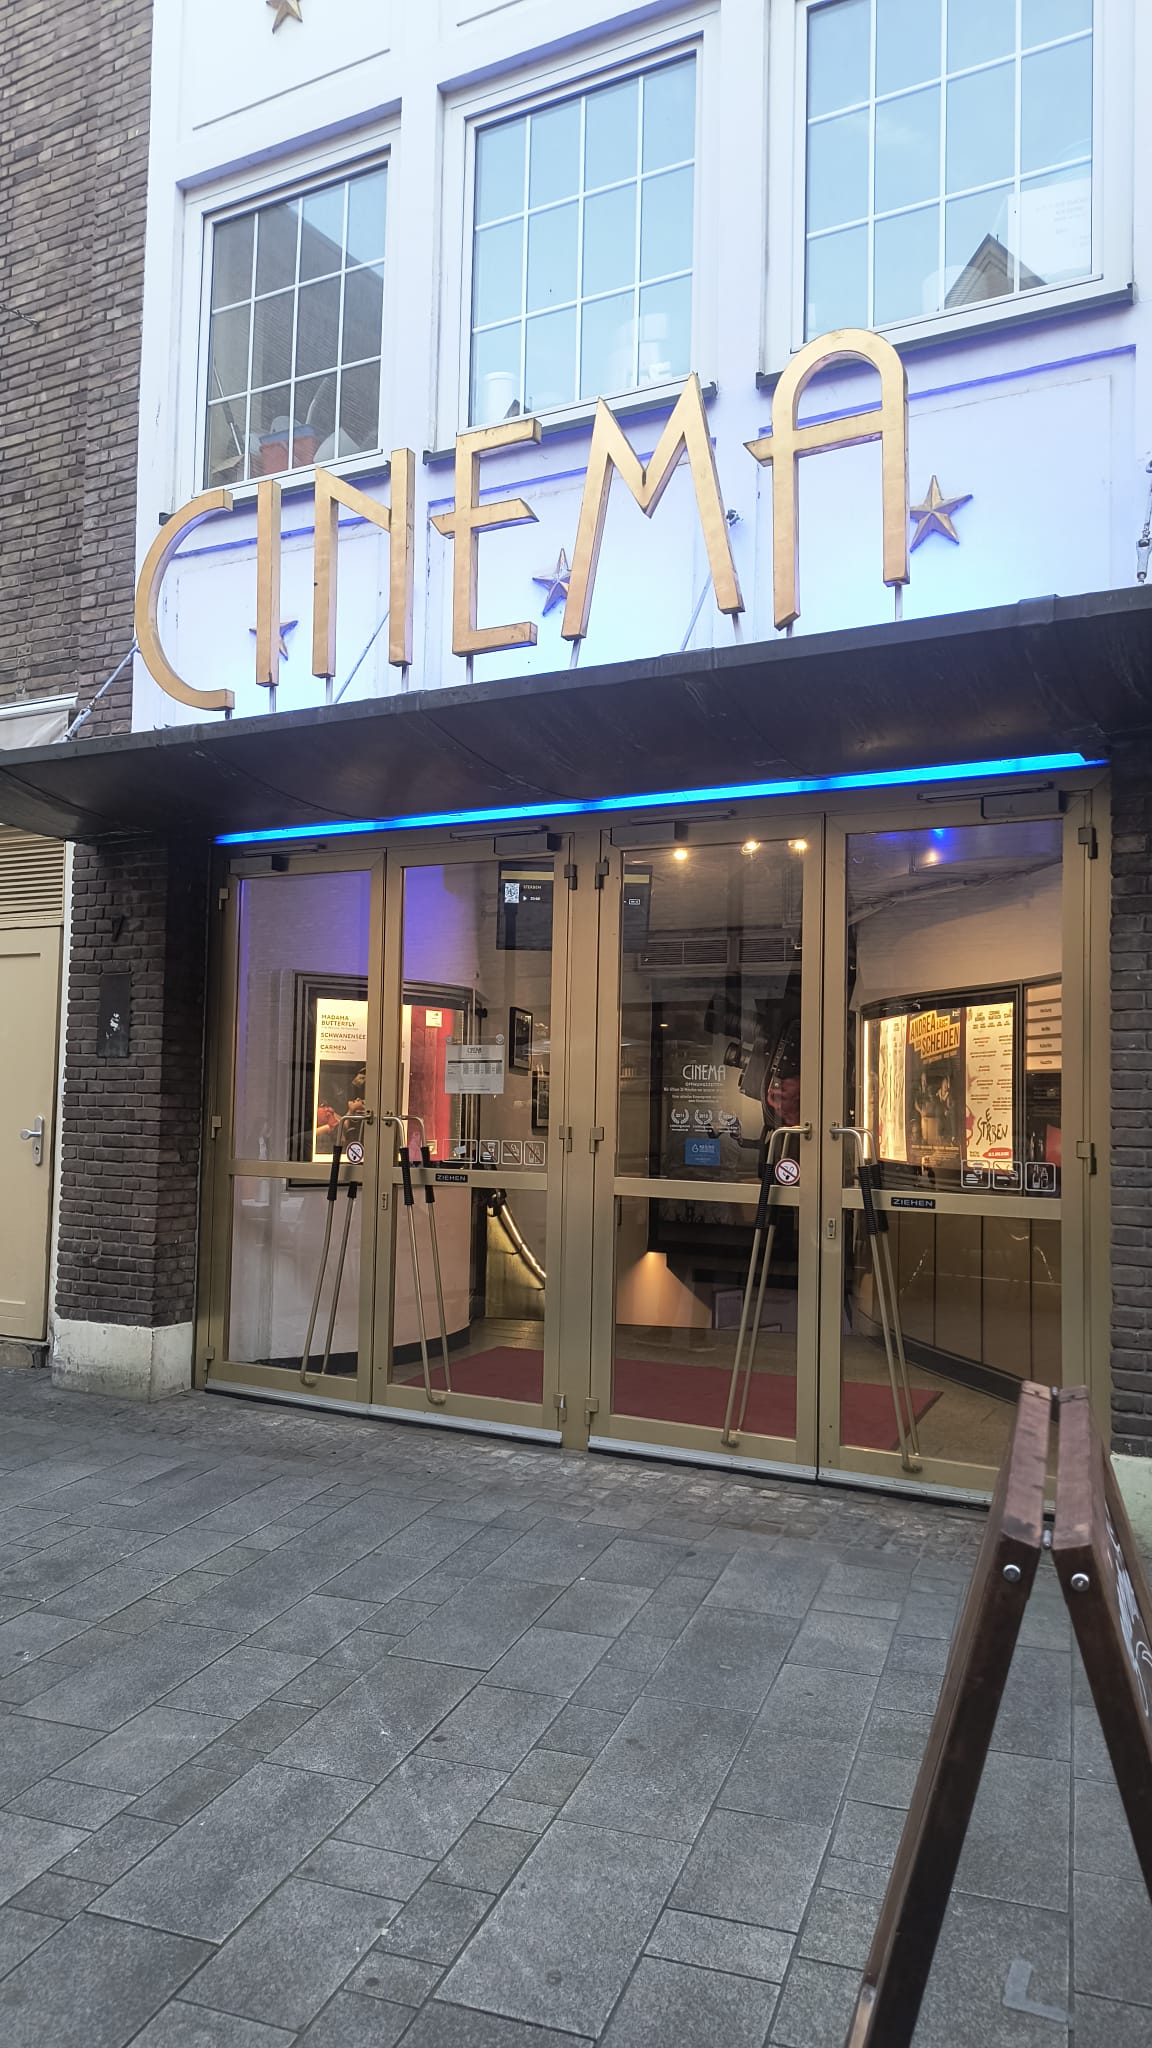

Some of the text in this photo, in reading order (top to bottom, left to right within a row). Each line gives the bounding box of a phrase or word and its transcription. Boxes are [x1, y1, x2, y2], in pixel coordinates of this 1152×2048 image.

[135, 328, 911, 711] CINEMA
[910, 1012, 937, 1041] ANDREA
[320, 1032, 367, 1040] SCHWANENSEE
[921, 1025, 960, 1057] SCHEIDEN
[682, 1064, 726, 1082] CINEMA
[436, 1174, 466, 1182] ZIEHEN
[892, 1198, 933, 1207] ZIEHEN
